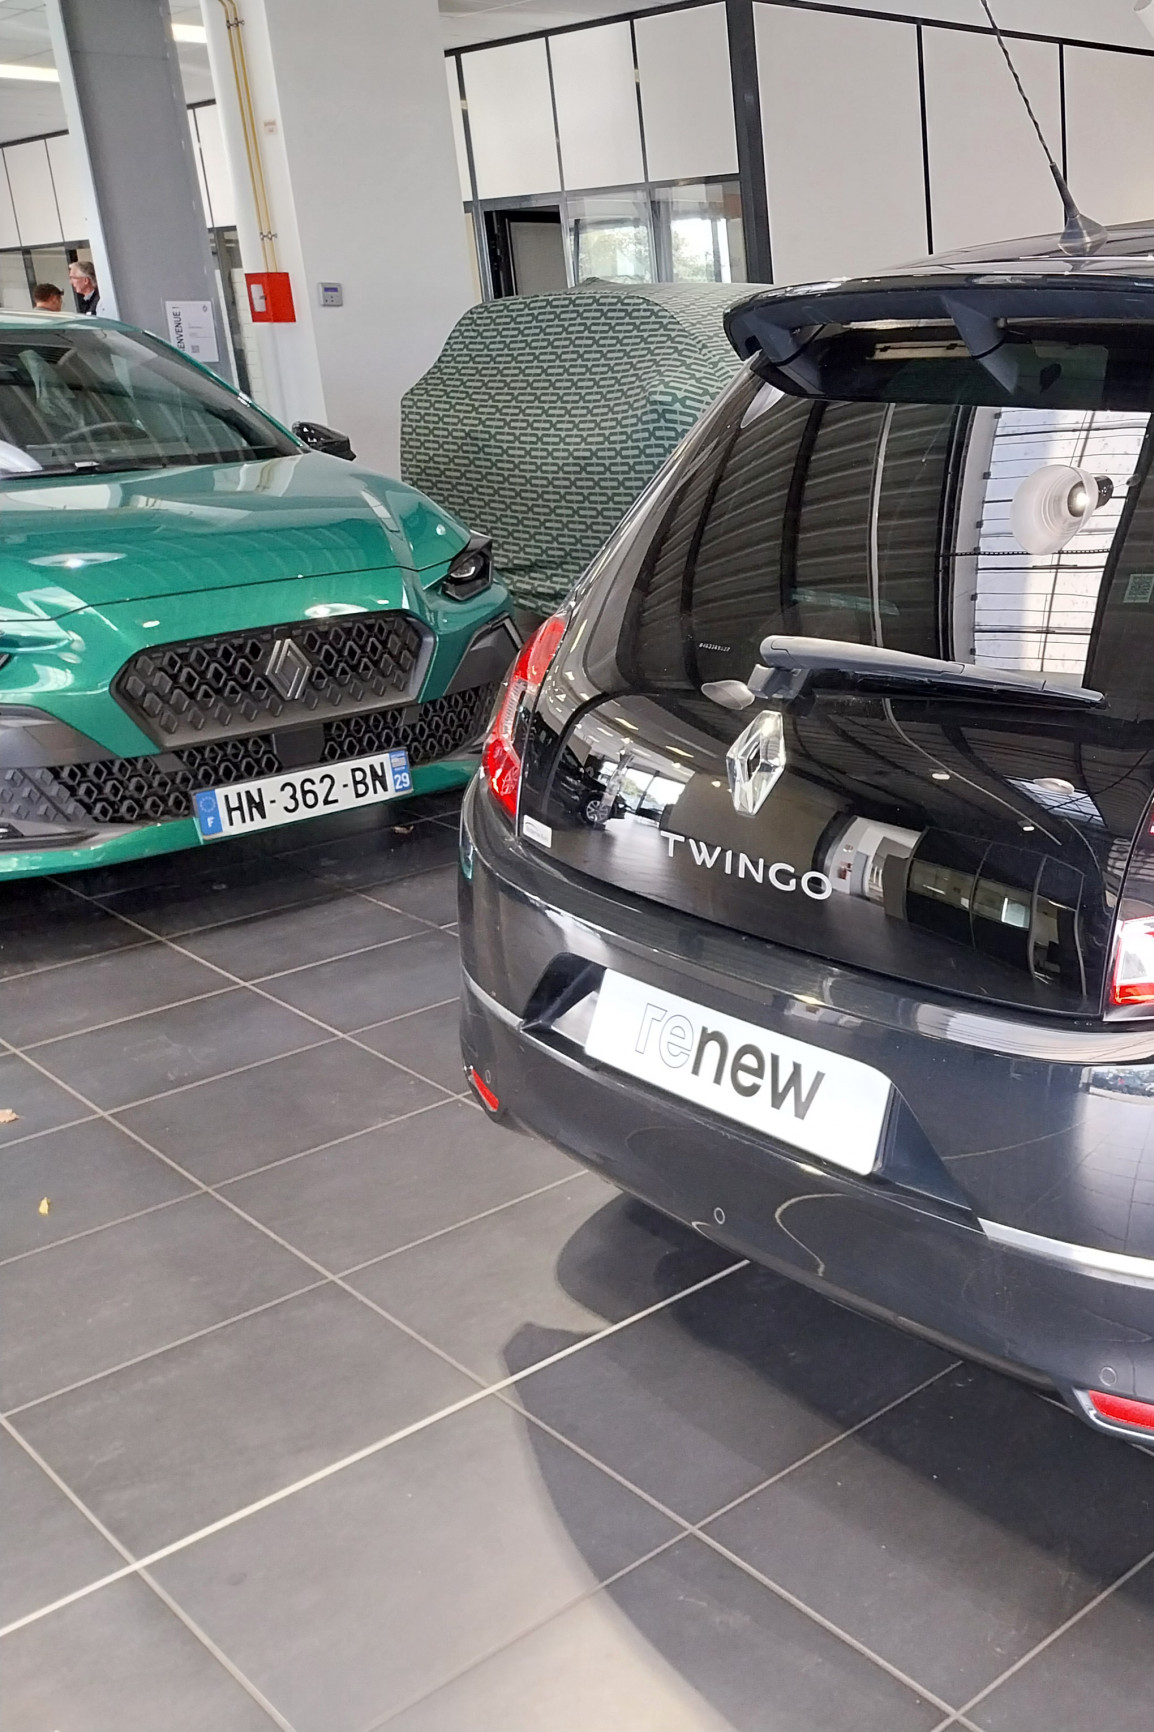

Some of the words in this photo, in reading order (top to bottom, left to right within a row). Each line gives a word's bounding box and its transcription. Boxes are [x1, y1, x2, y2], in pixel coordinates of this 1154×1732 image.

[207, 816, 215, 828] F
[223, 761, 389, 827] HN-362-BN
[394, 771, 410, 790] 29
[660, 830, 833, 900] TWINGO
[634, 1002, 826, 1121] renew
